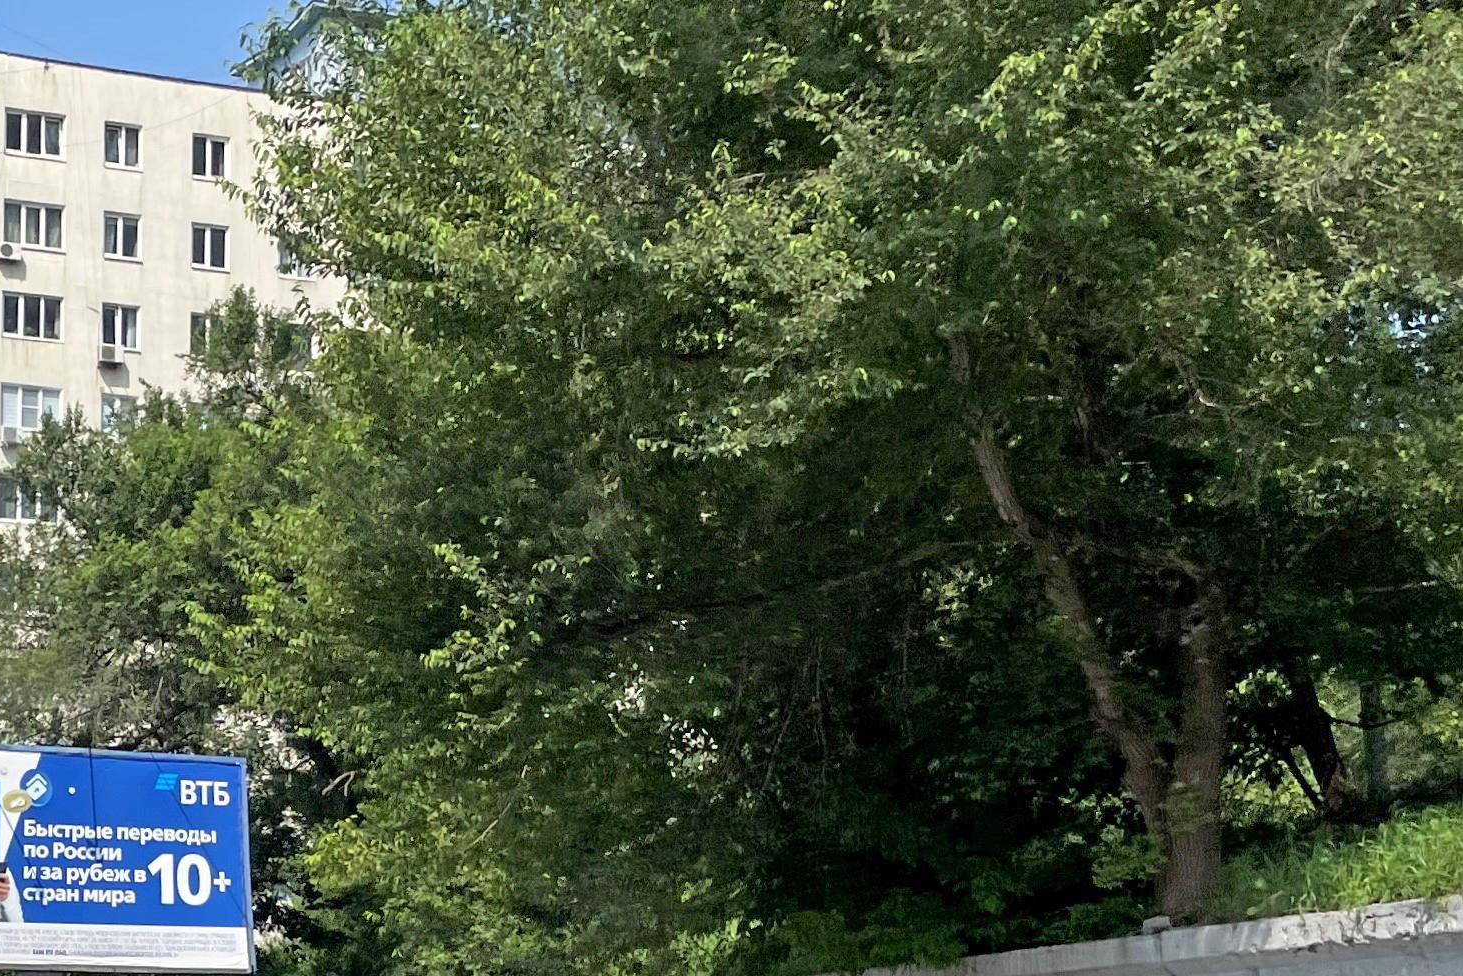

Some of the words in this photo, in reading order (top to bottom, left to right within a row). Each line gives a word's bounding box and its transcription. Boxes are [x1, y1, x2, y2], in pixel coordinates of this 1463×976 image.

[179, 779, 231, 806] ВТБ
[23, 819, 112, 842] Быстрые
[116, 826, 217, 846] переводы
[23, 844, 49, 858] по
[52, 843, 122, 861] России
[22, 865, 37, 880] и
[40, 866, 63, 881] за
[66, 862, 131, 885] рубеж
[134, 869, 147, 883] в
[22, 886, 79, 906] стран
[83, 889, 136, 907] мира
